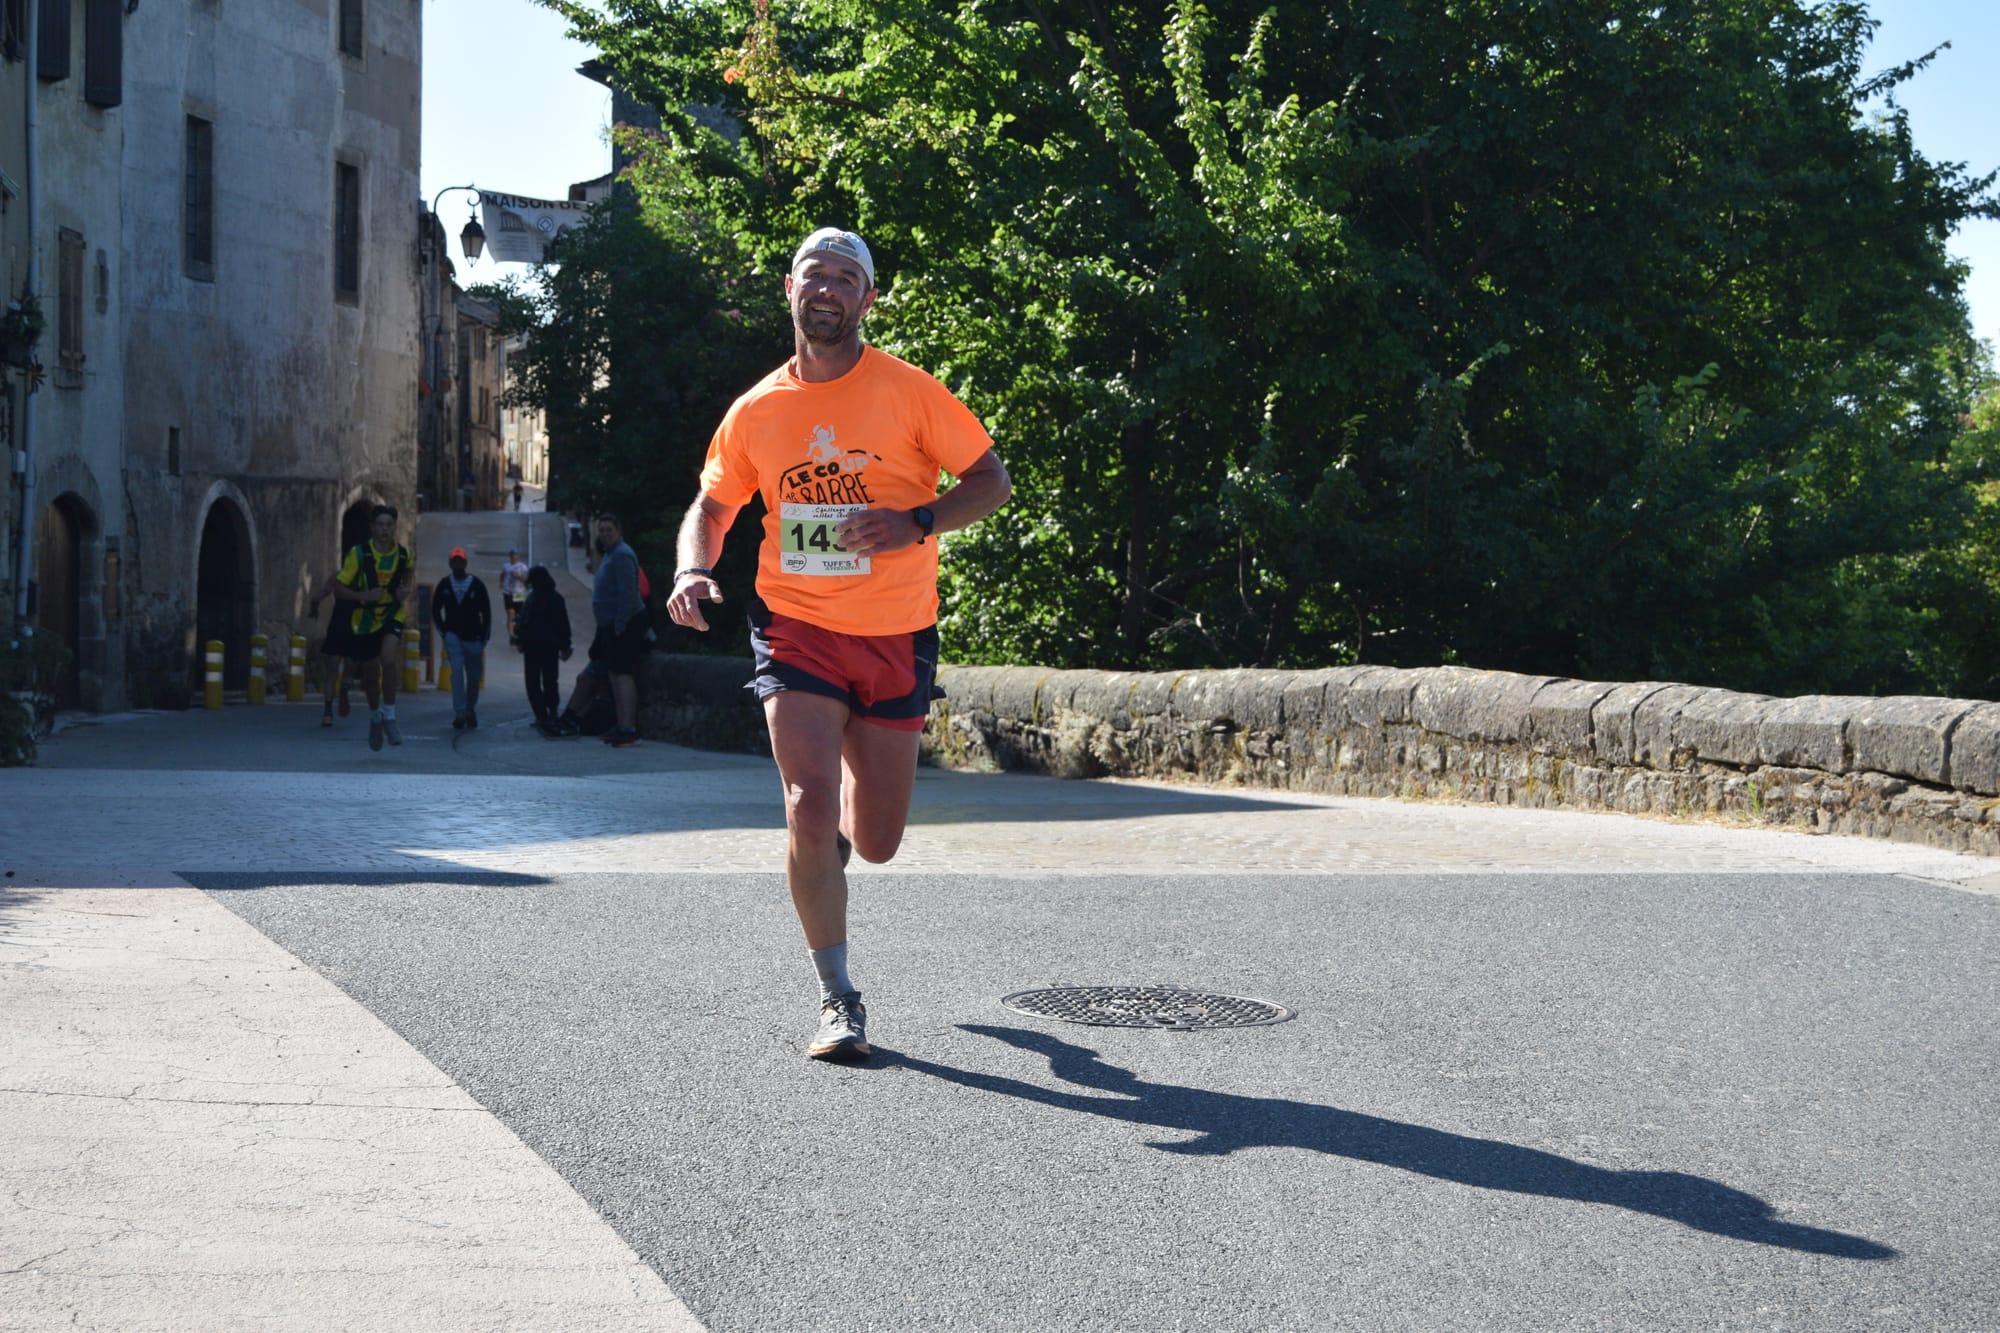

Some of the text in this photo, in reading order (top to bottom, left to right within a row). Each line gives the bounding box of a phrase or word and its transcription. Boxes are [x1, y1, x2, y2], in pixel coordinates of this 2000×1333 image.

[484, 194, 554, 209] MAISON
[787, 456, 869, 489] LE COUP
[800, 472, 875, 504] BARRE
